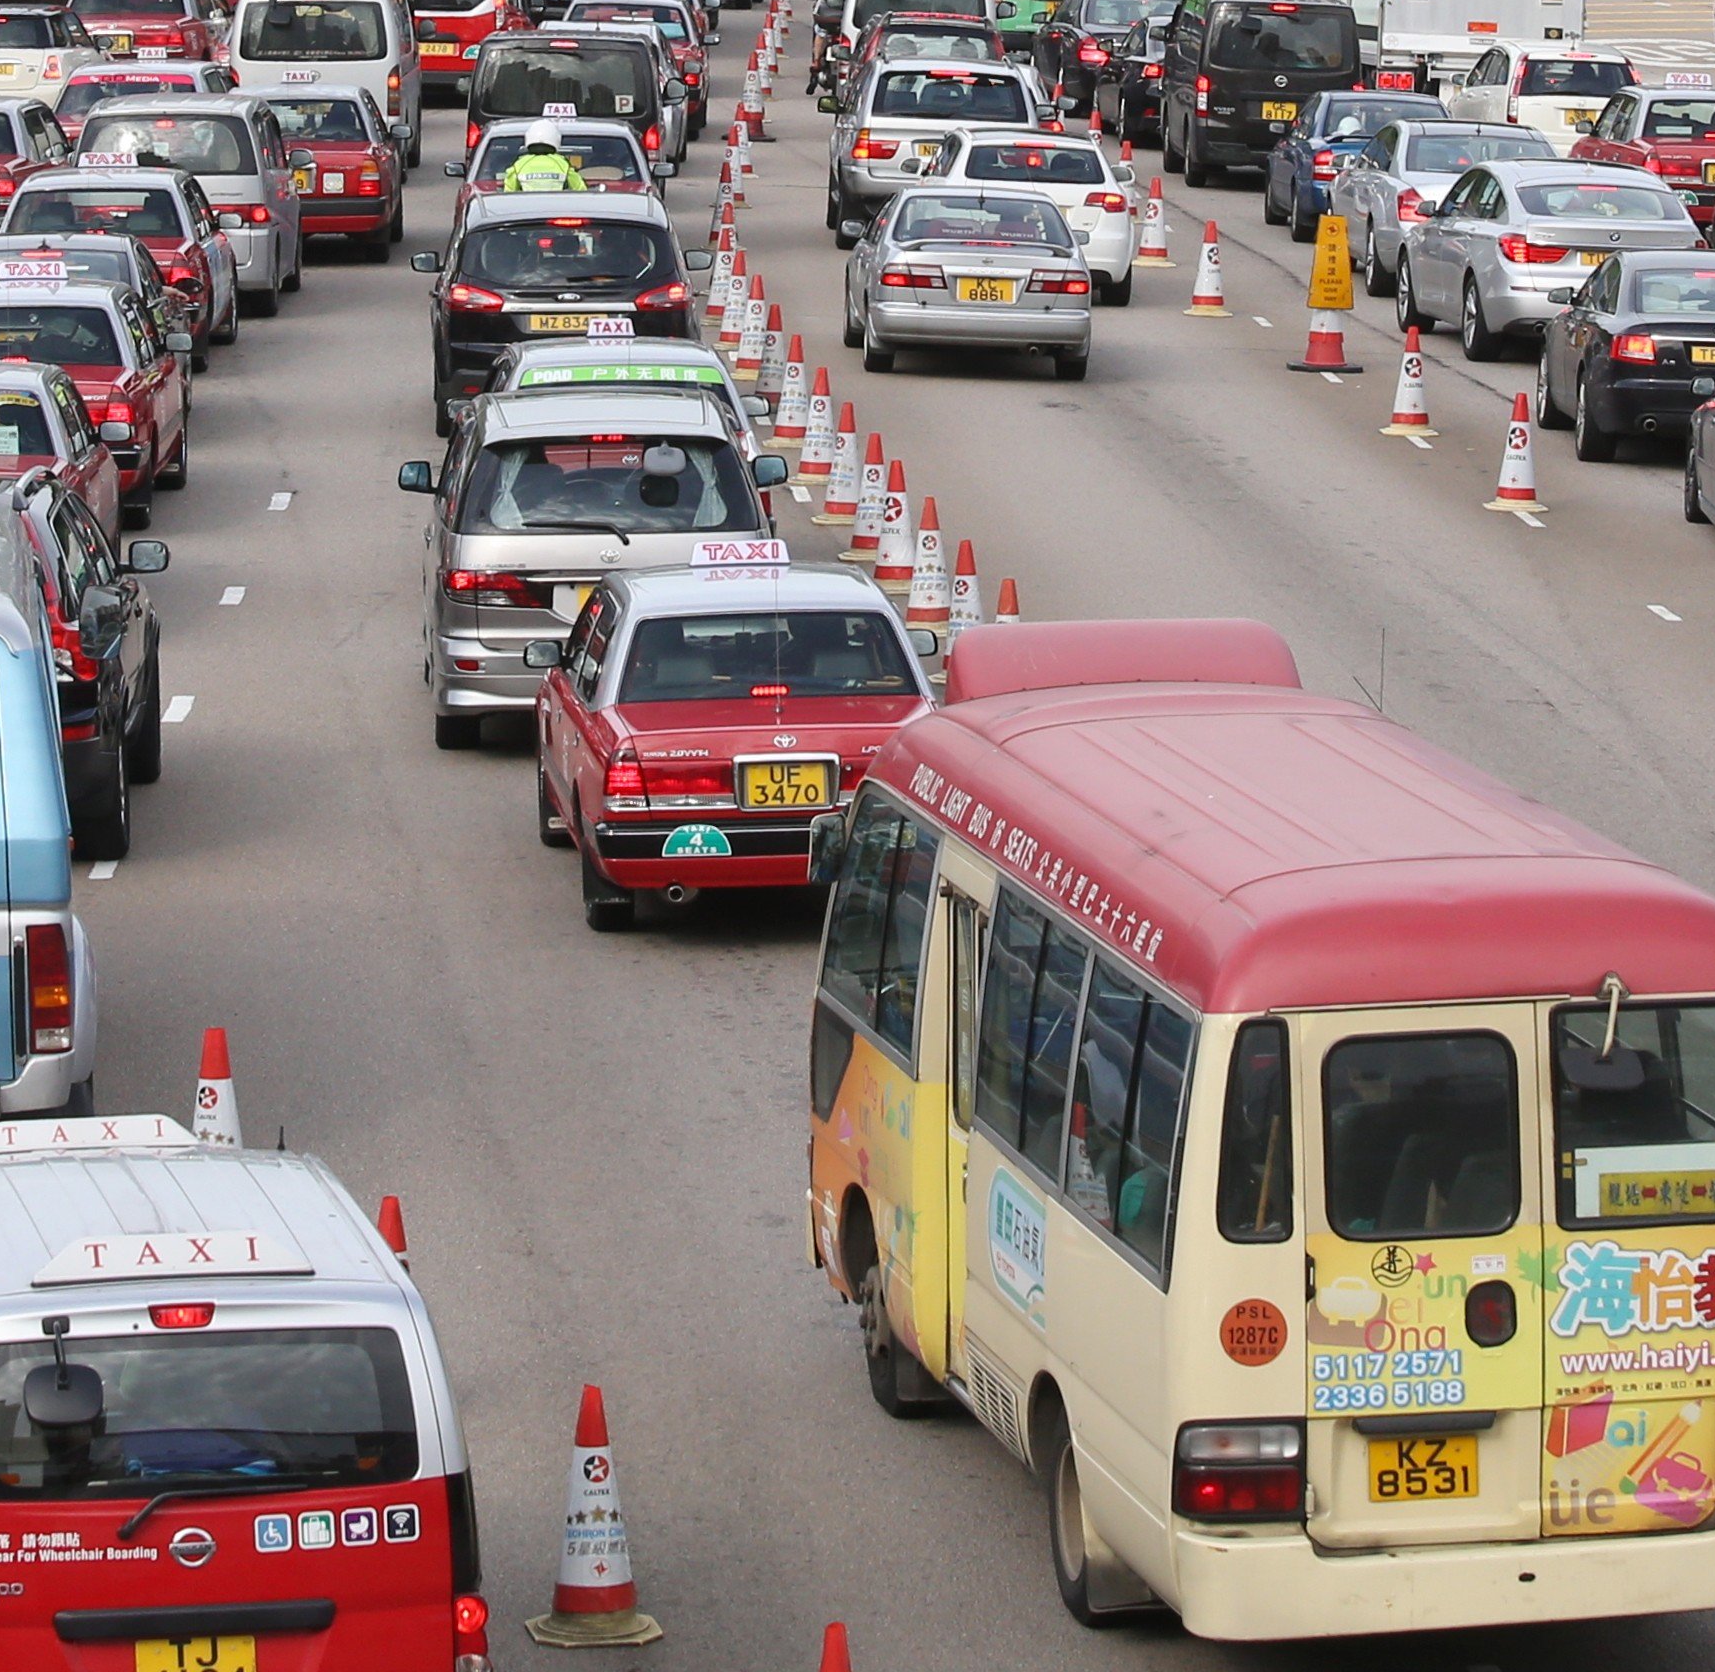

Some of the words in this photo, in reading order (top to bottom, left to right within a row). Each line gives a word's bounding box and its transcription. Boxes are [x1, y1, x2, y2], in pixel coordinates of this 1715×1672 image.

[139, 48, 166, 57] TAXI
[285, 72, 310, 81] TAXI
[1670, 72, 1710, 86] TAXI
[545, 104, 576, 116] TAXI
[619, 97, 630, 112] P
[85, 153, 132, 165] TAXI
[5, 263, 61, 276] TAXI
[976, 277, 998, 289] KC
[968, 289, 1004, 301] 8861
[539, 316, 559, 330] MZ
[593, 319, 631, 335] TAXI
[533, 369, 573, 383] POAD
[702, 542, 780, 560] TAXI
[769, 765, 802, 784] UF
[753, 784, 820, 804] 3470
[688, 833, 703, 846] 4
[676, 846, 718, 854] SEATS
[908, 762, 945, 805] PUBLIC
[940, 785, 970, 825] LIGHT
[967, 802, 993, 841] BUS
[990, 818, 1006, 850] 16
[1001, 826, 1039, 873] SEATS
[1034, 848, 1165, 963] 公共小型巴士十六座位
[2, 1118, 166, 1146] TAXI
[83, 1235, 260, 1269] TAXI
[1235, 1305, 1271, 1320] PSL
[1227, 1326, 1278, 1346] 1287C
[1313, 1352, 1386, 1381] 5117
[1392, 1348, 1463, 1377] 2571
[1313, 1384, 1386, 1411] 2336
[1392, 1378, 1465, 1407] 5188
[1606, 1411, 1647, 1449] ai
[1397, 1441, 1447, 1469] KZ
[1377, 1467, 1470, 1497] 8531
[583, 1488, 611, 1497] CALTEX
[21, 1532, 81, 1548] 請勿跟貼
[17, 1548, 36, 1562] For
[38, 1547, 104, 1562] Wheelchair
[106, 1546, 158, 1562] Boarding
[169, 1635, 219, 1668] TJ
